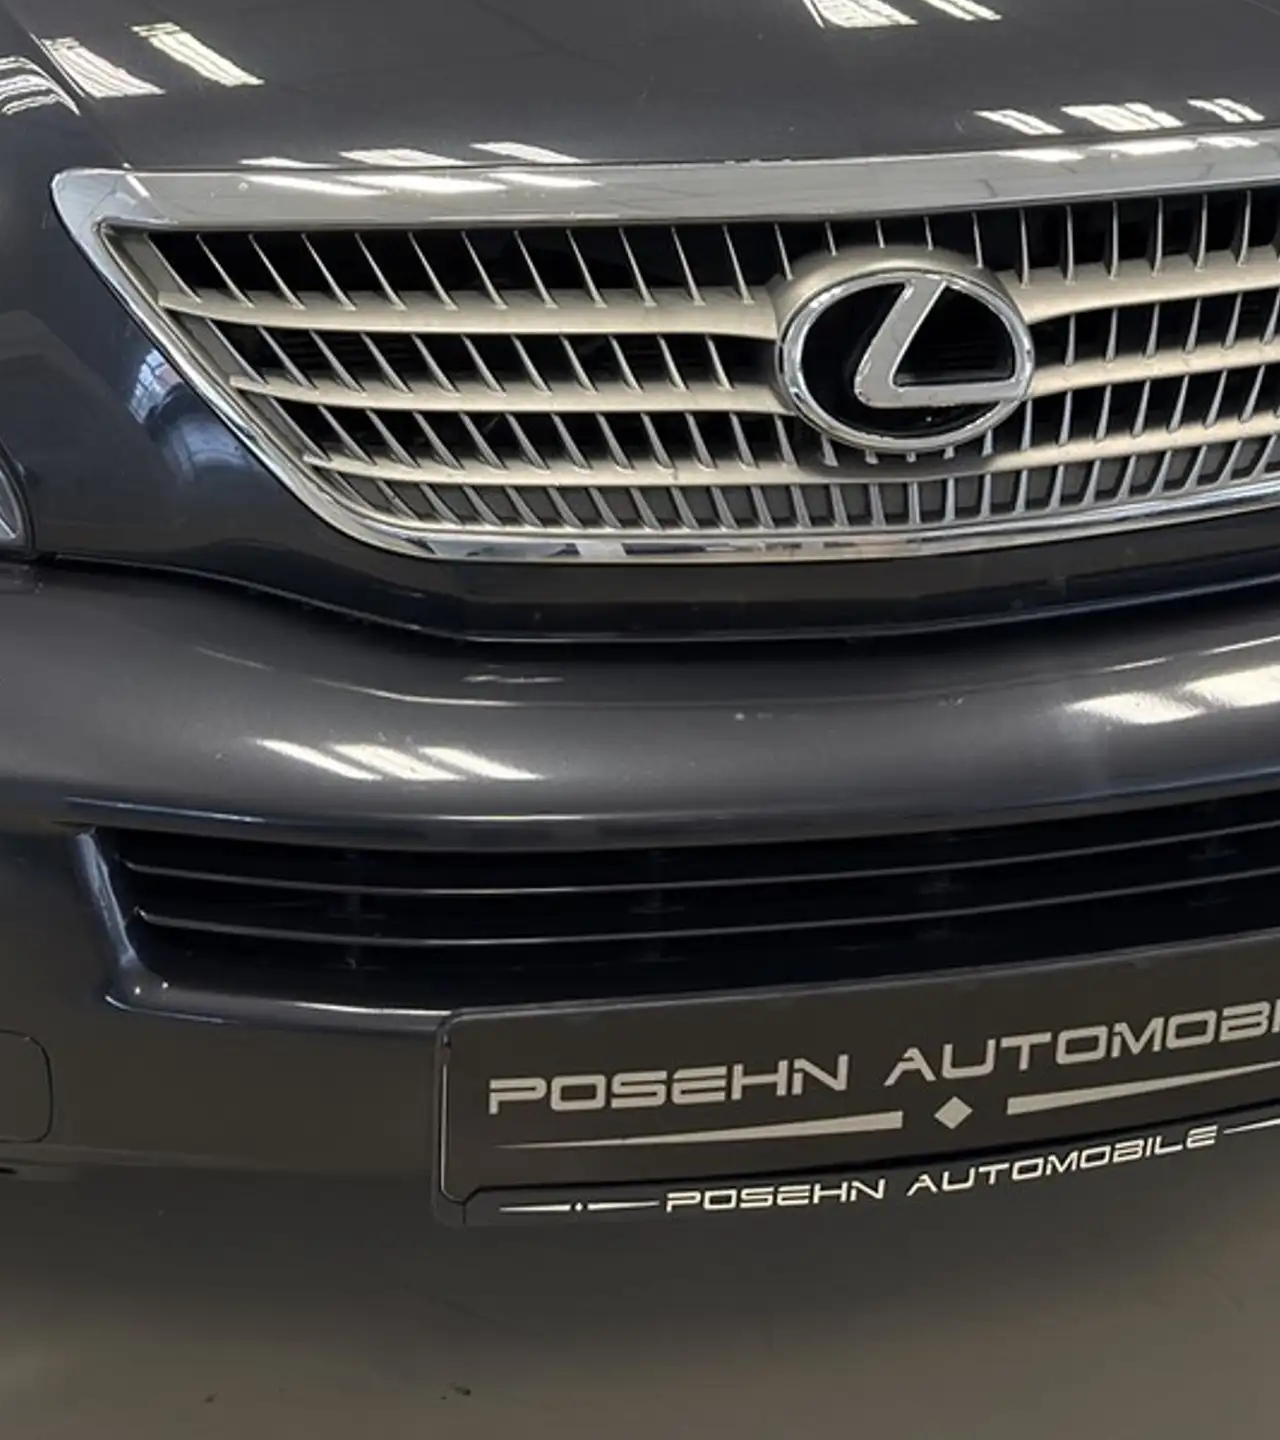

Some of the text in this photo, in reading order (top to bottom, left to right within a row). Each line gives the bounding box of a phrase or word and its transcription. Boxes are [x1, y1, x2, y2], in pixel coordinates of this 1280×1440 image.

[489, 1054, 849, 1115] POSEHN
[665, 1125, 1218, 1213] POSEHN AUTOMOBILE
